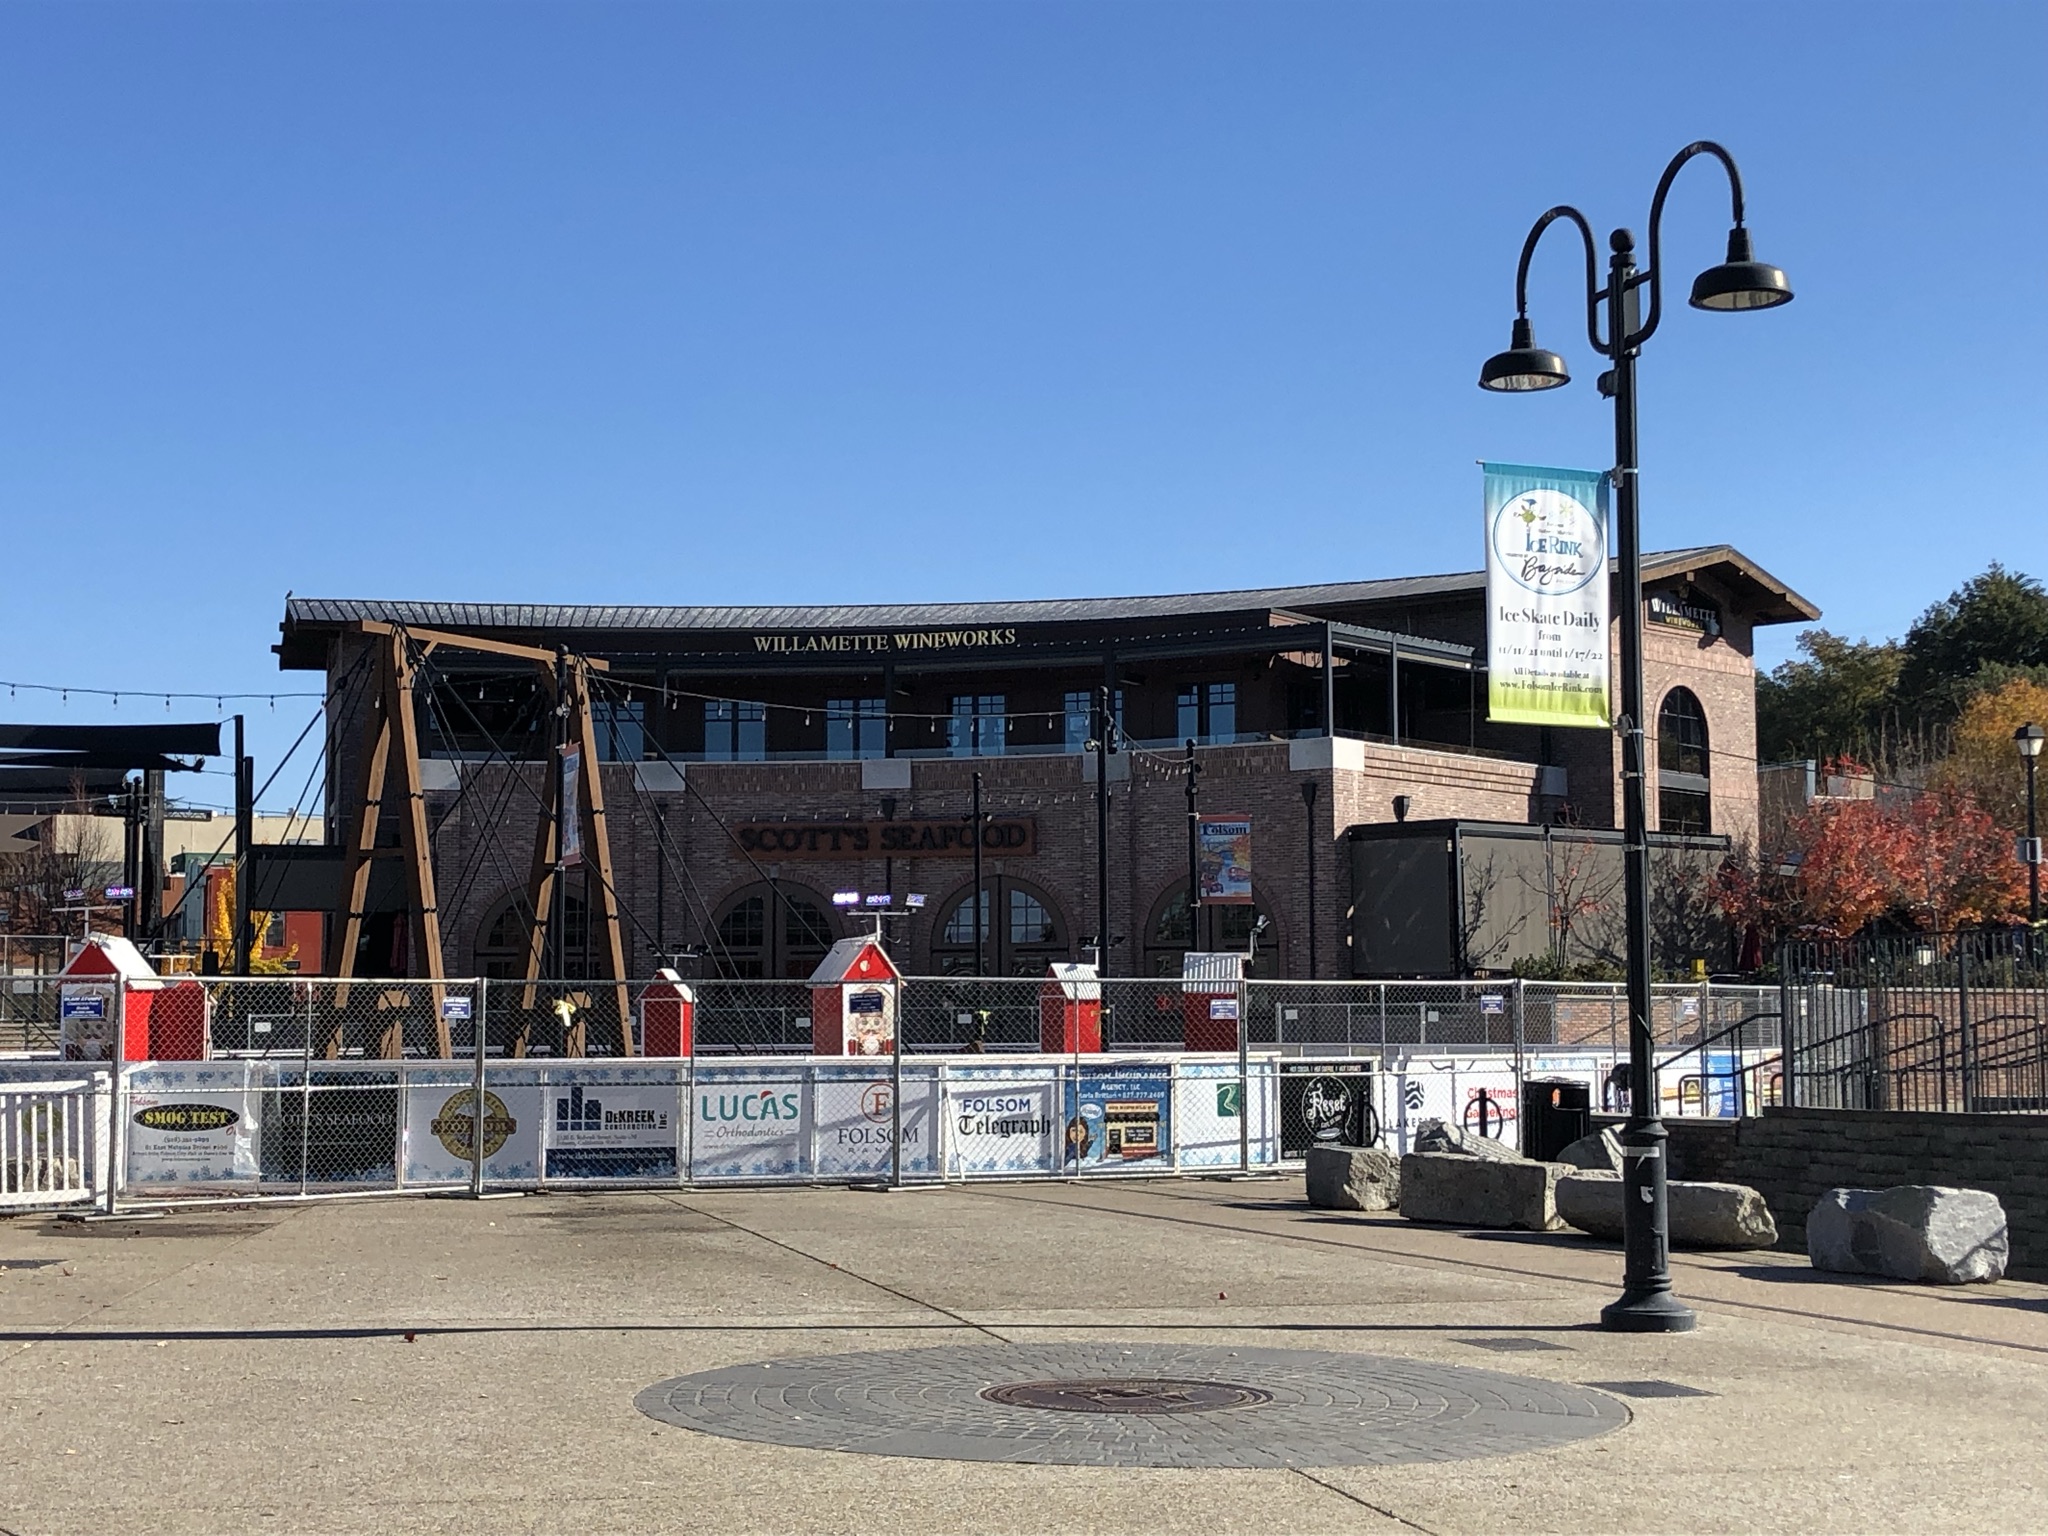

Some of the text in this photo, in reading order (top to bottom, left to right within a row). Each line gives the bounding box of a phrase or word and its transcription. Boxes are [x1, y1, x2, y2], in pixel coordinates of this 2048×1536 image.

[1521, 556, 1586, 585] Bayside
[1500, 606, 1601, 632] Ice Skate Daily
[1651, 597, 1716, 621] WILLAMETTE
[754, 628, 1016, 652] WILLAMETTE WINEWORKS
[1538, 630, 1561, 641] from
[1540, 647, 1562, 658] until
[1565, 648, 1603, 662] 1/17/22
[739, 823, 1026, 851] SCOTT'S SEAFOOD
[1203, 823, 1247, 835] Folsom
[872, 1093, 889, 1116] F
[1306, 1083, 1347, 1121] Reset
[1467, 1087, 1518, 1099] Chstmas
[702, 1093, 799, 1122] LUCAS
[963, 1098, 1031, 1113] FOLSOM
[144, 1111, 228, 1124] SMOG TEST
[604, 1123, 656, 1131] CONSTRUCTION
[958, 1114, 1051, 1138] Telegraph
[717, 1124, 784, 1138] Orthodontics
